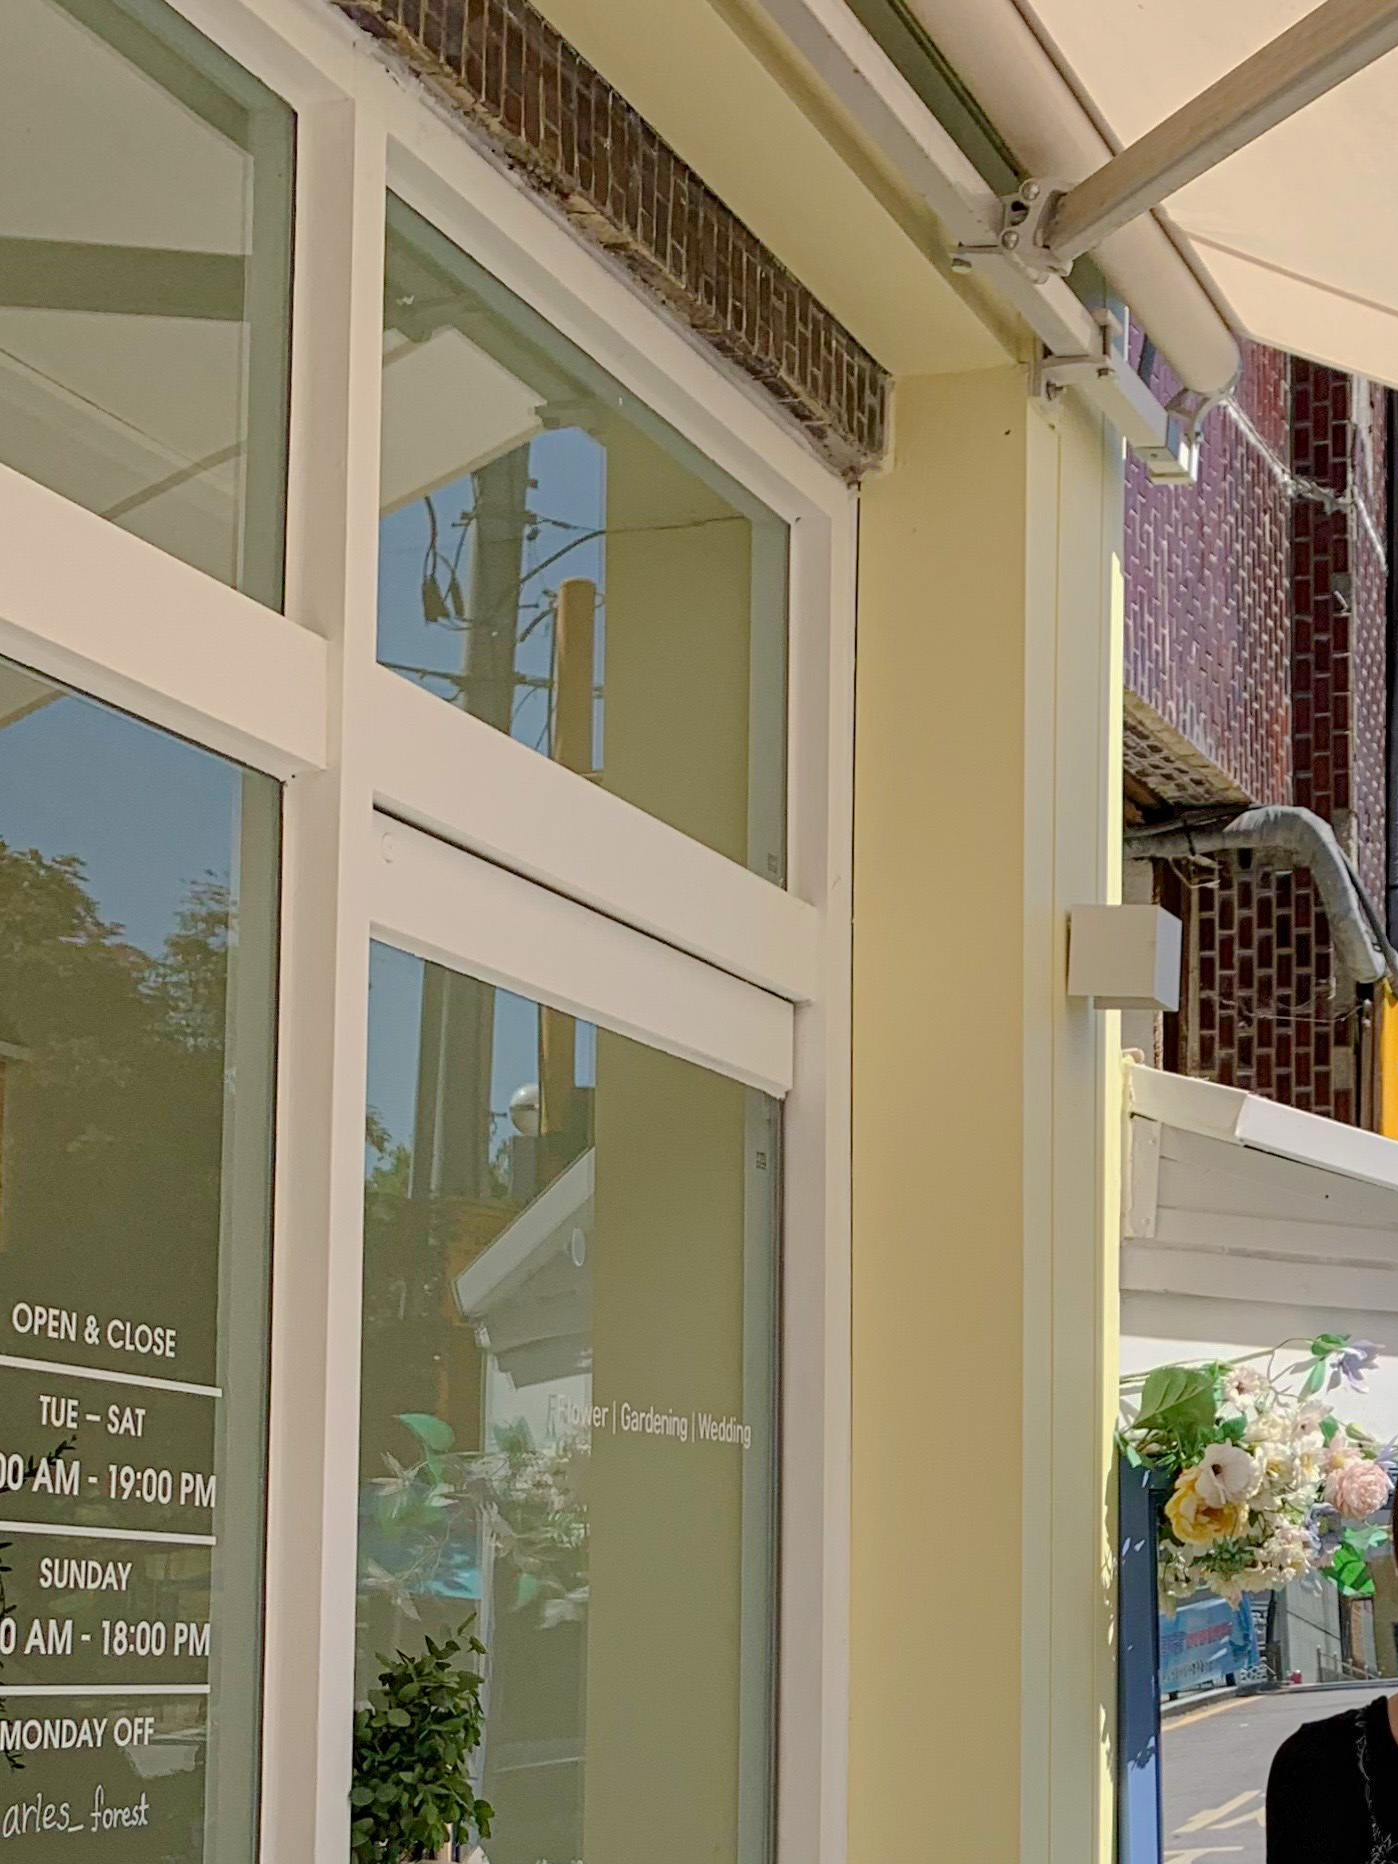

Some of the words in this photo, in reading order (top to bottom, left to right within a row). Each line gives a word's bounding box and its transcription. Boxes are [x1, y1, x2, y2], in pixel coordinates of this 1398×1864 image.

[12, 1302, 78, 1342] OPEN
[84, 1315, 100, 1345] &
[107, 1319, 177, 1358] CLOSE
[39, 1395, 79, 1429] TUE
[107, 1404, 146, 1437] SAT
[557, 1394, 609, 1427] Flower
[621, 1402, 688, 1442] Gardening
[698, 1412, 751, 1449] Wedding
[32, 1457, 81, 1496] AM
[109, 1464, 173, 1505] 19:00
[180, 1471, 217, 1508] PM
[40, 1557, 132, 1591] SUNDAY
[24, 1618, 73, 1655] AM
[102, 1620, 166, 1656] 18:00
[174, 1622, 211, 1656] PM
[0, 1718, 108, 1750] MONDAY
[114, 1717, 155, 1746] OFF
